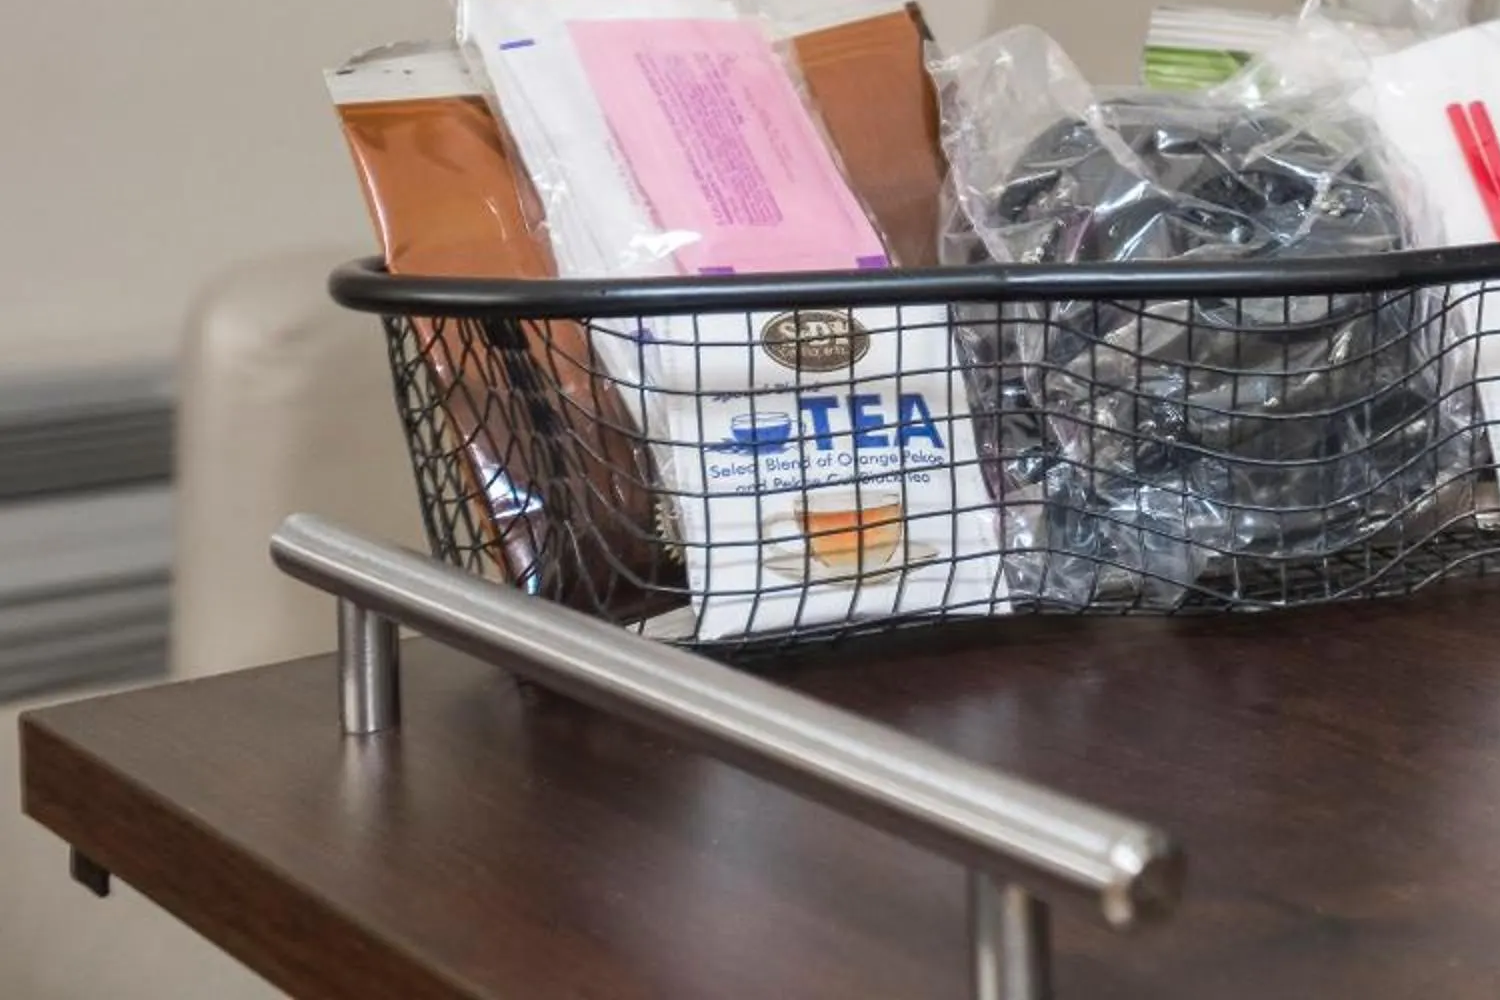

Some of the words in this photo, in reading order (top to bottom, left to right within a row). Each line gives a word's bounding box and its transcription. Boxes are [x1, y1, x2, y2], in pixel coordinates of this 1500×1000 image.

[798, 392, 945, 452] TEA
[708, 462, 758, 479] Selec
[816, 453, 833, 467] of
[837, 451, 898, 468] Oange
